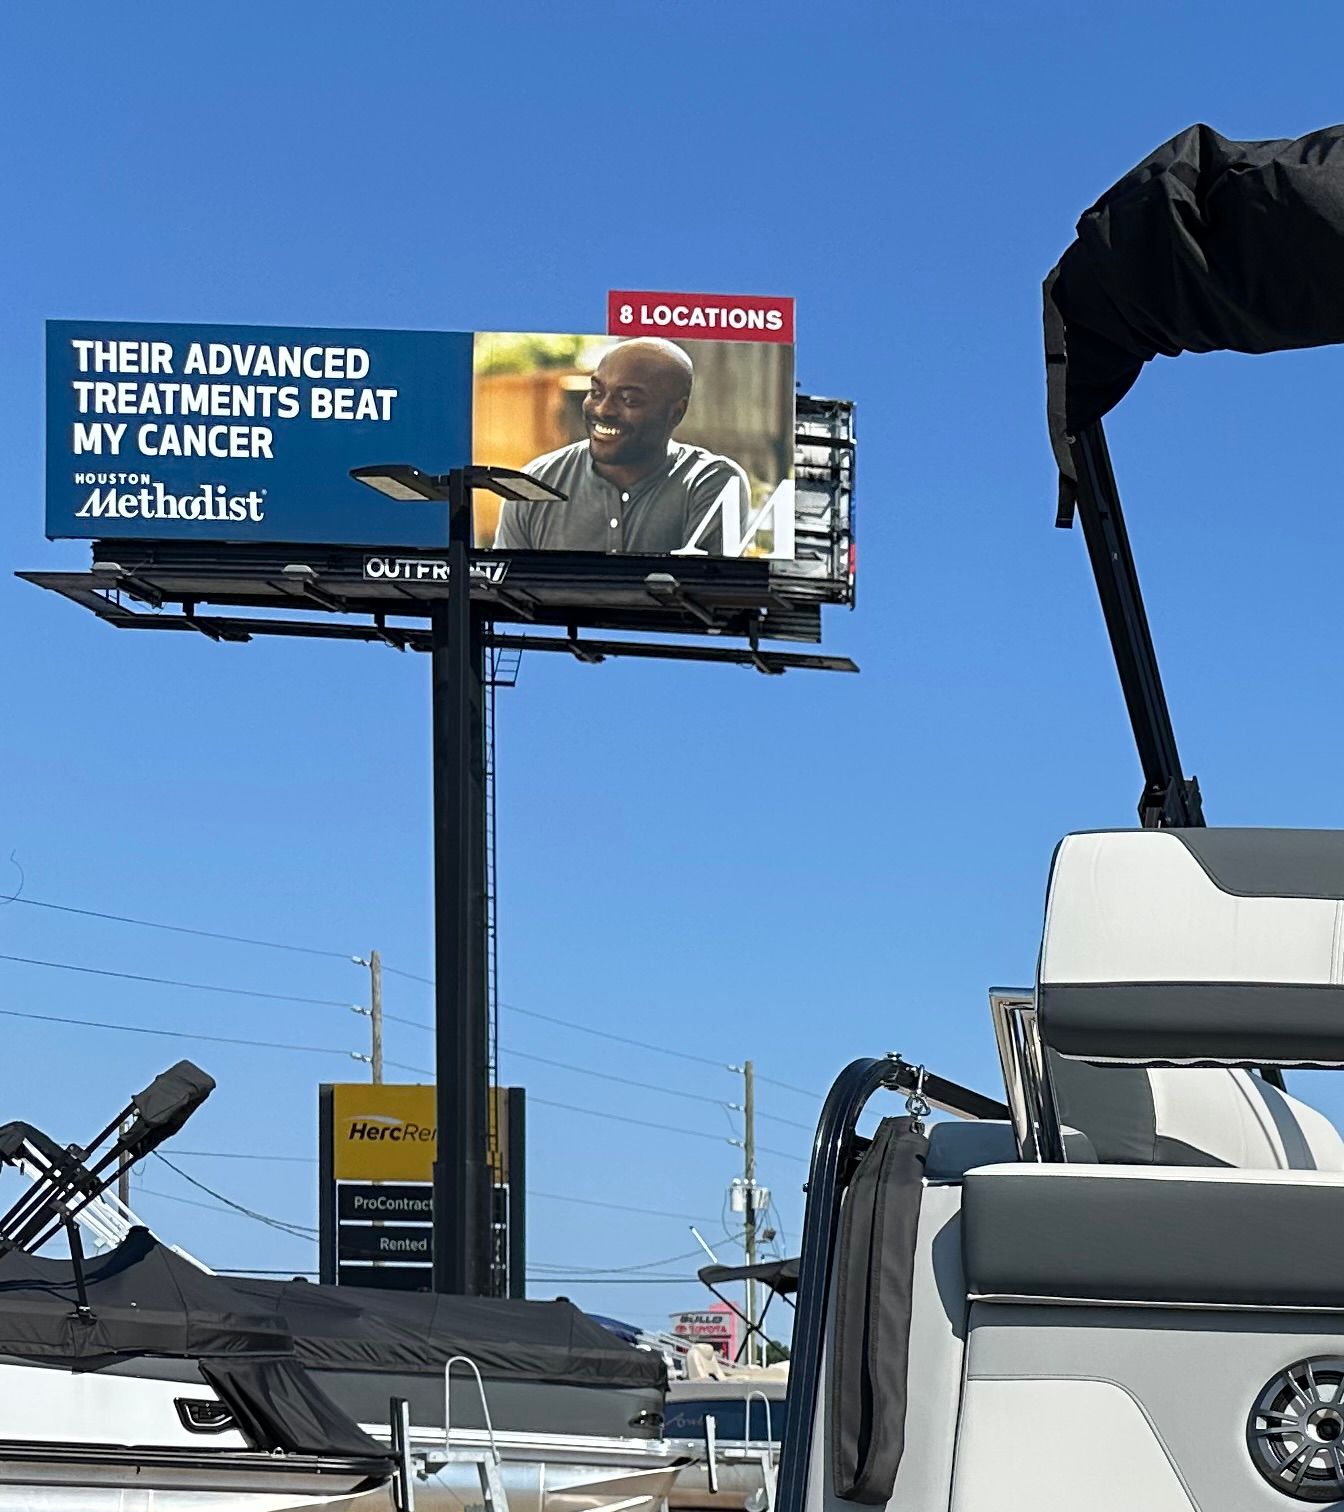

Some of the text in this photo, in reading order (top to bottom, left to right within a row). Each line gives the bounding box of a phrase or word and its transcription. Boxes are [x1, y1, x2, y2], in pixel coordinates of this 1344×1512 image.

[619, 304, 783, 330] 8 LOCATIONS
[72, 339, 370, 380] THEIR ADVANCED
[72, 380, 398, 421] TREATMENTS BEAT
[73, 422, 274, 459] MY CANCER
[75, 473, 150, 485] HOUSTON
[349, 1122, 437, 1141] HercRe
[380, 1237, 428, 1251] Rented
